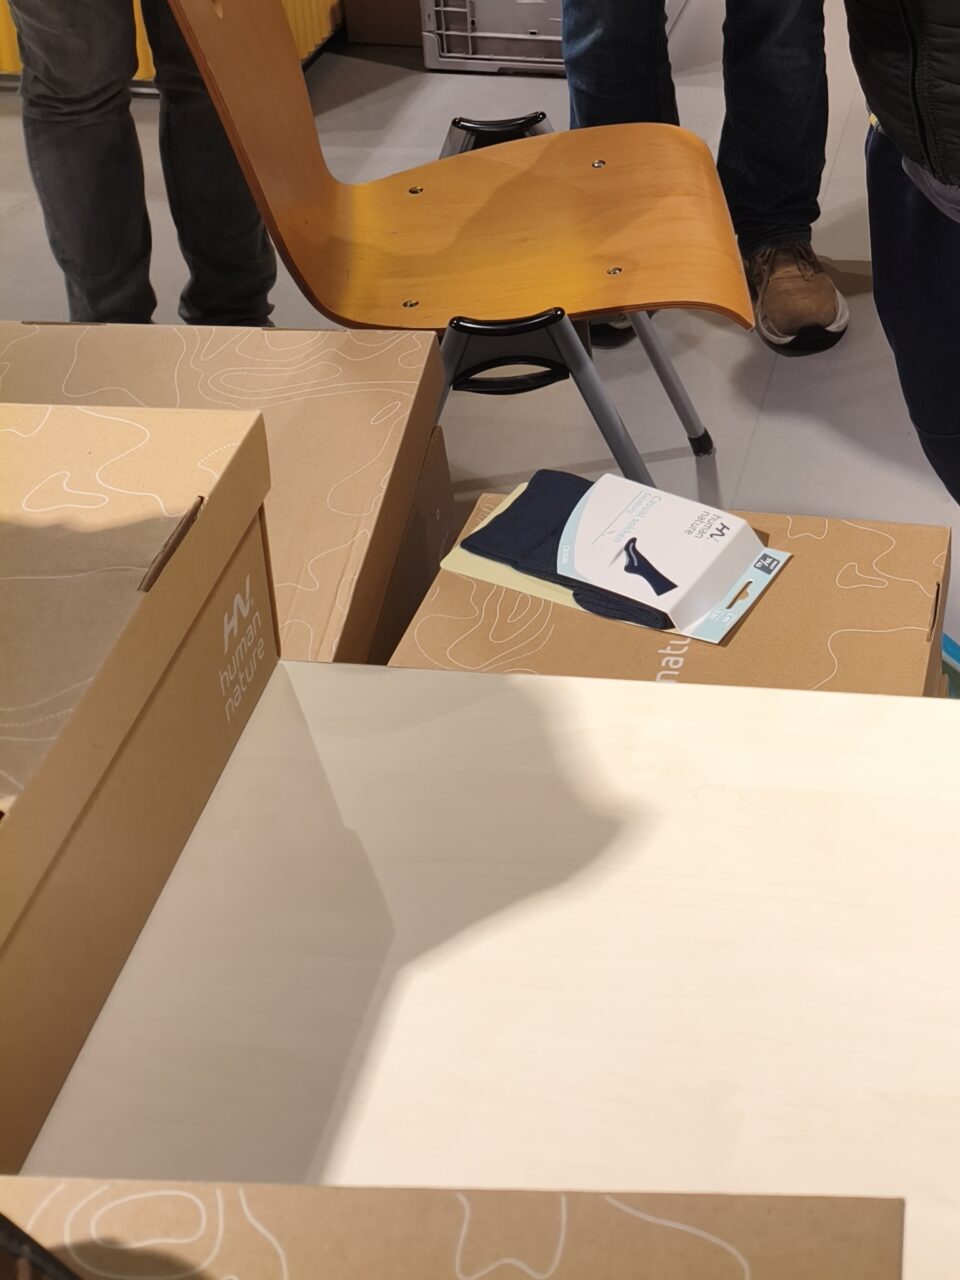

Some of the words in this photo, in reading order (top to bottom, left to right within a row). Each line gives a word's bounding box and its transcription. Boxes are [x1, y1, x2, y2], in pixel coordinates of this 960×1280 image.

[684, 510, 710, 536] nature
[694, 513, 723, 539] human
[218, 611, 262, 696] human
[225, 638, 265, 723] nature
